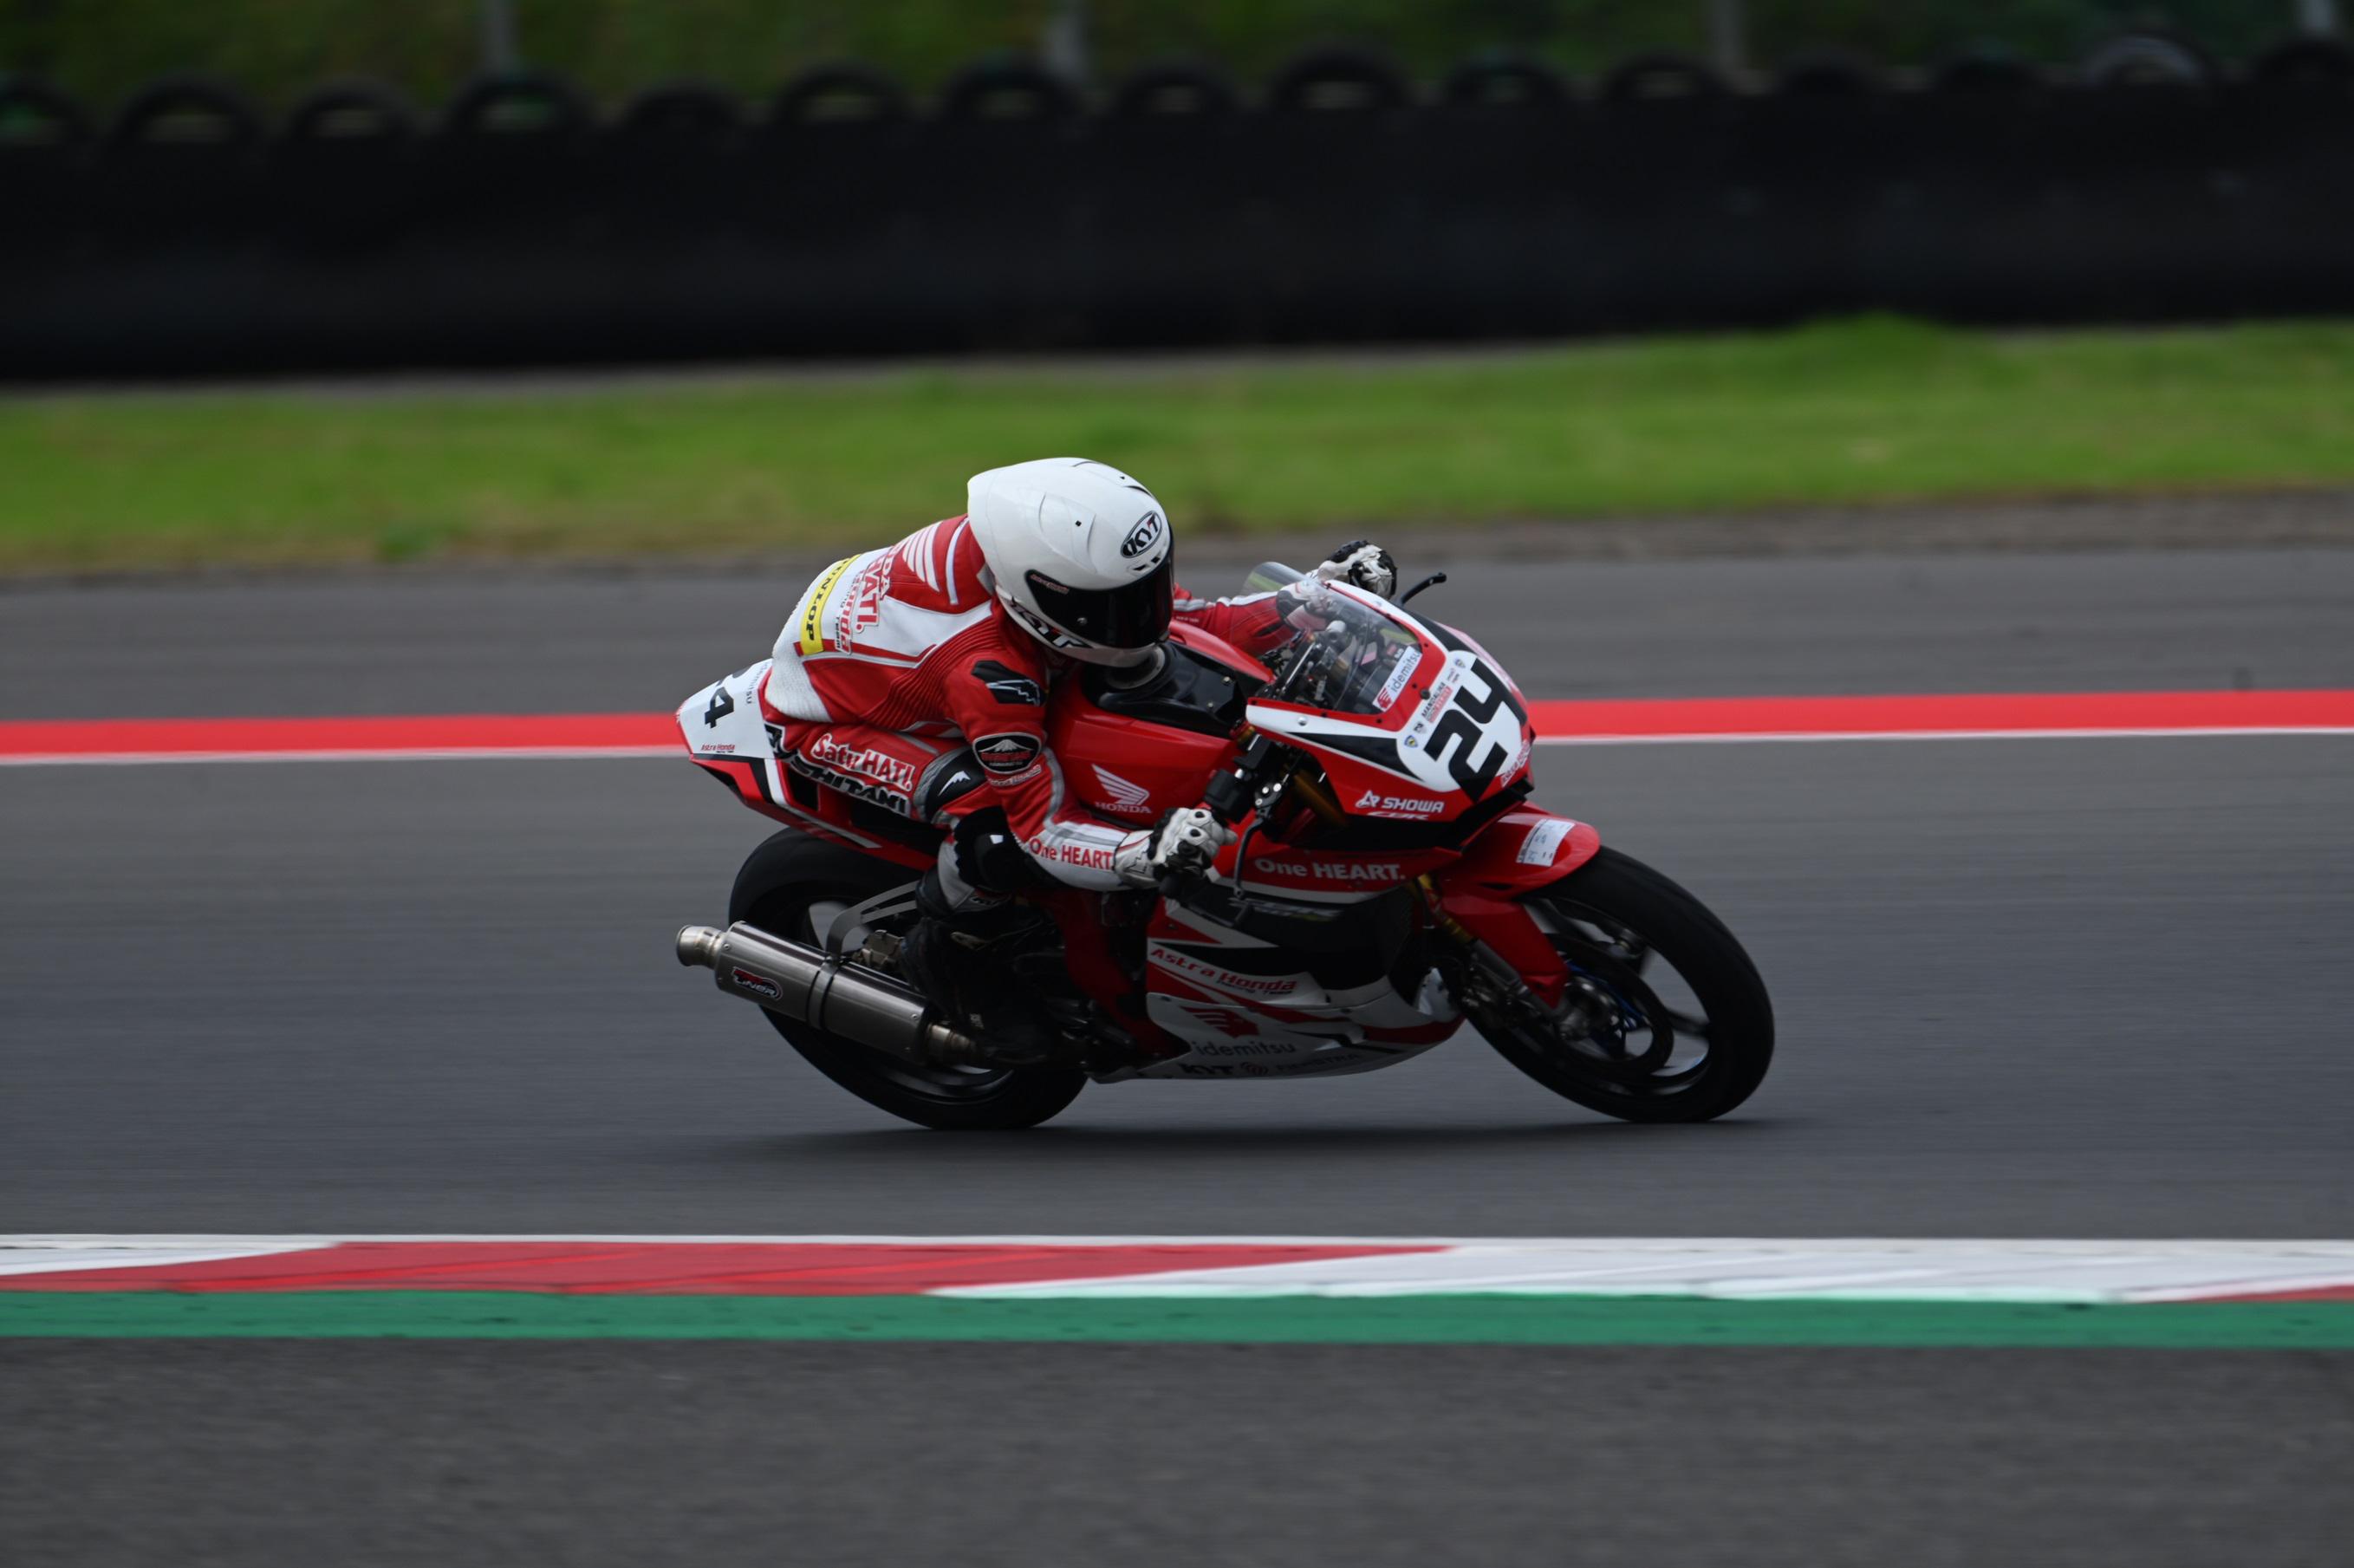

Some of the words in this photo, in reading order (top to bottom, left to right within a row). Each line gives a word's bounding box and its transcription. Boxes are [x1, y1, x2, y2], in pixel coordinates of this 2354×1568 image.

[1122, 513, 1159, 556] KYT
[1423, 657, 1528, 803] 24
[813, 734, 861, 770] Satu
[1095, 802, 1152, 814] HONDA
[1382, 797, 1445, 813] SHOWA
[1029, 838, 1058, 861] One
[1254, 858, 1309, 877] One
[1311, 862, 1406, 881] HEART.
[1150, 947, 1215, 978] Astra
[1219, 972, 1297, 991] Honda
[1193, 1040, 1297, 1056] idemitsu
